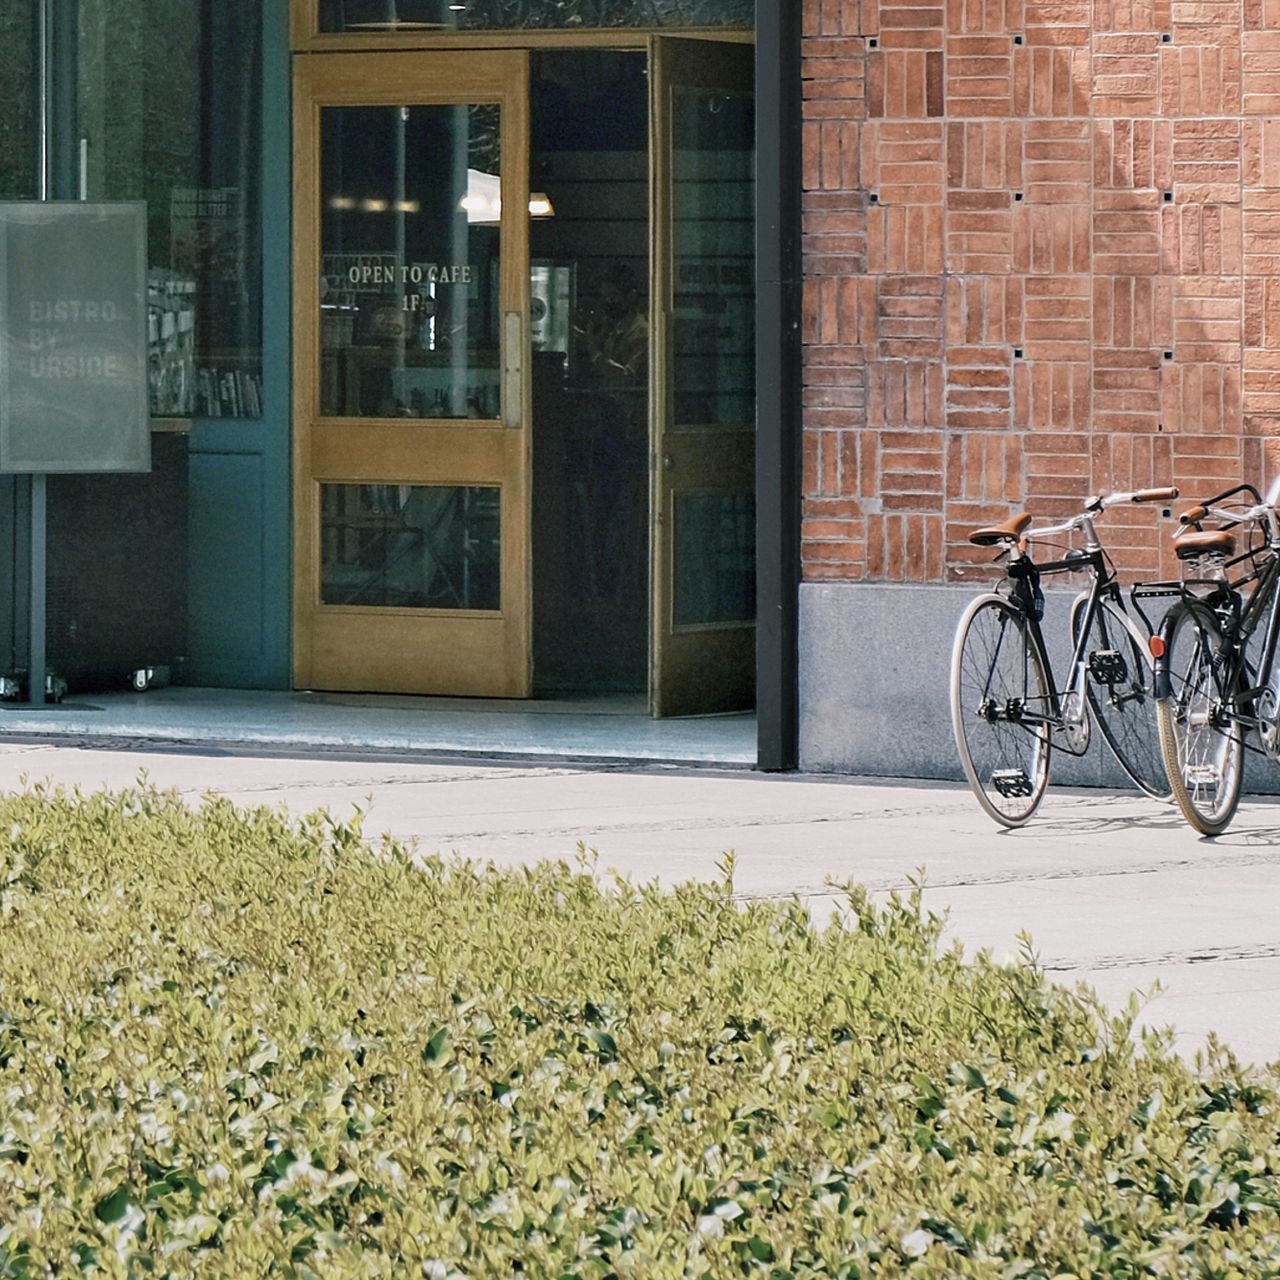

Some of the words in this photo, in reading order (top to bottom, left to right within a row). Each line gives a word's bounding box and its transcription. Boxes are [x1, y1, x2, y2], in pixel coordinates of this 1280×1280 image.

[348, 266, 395, 284] OPEN
[401, 266, 423, 284] TO
[428, 265, 472, 284] CAFE
[29, 299, 117, 323] BISTRO
[29, 328, 59, 351] BY
[30, 354, 119, 378] URSIDE
